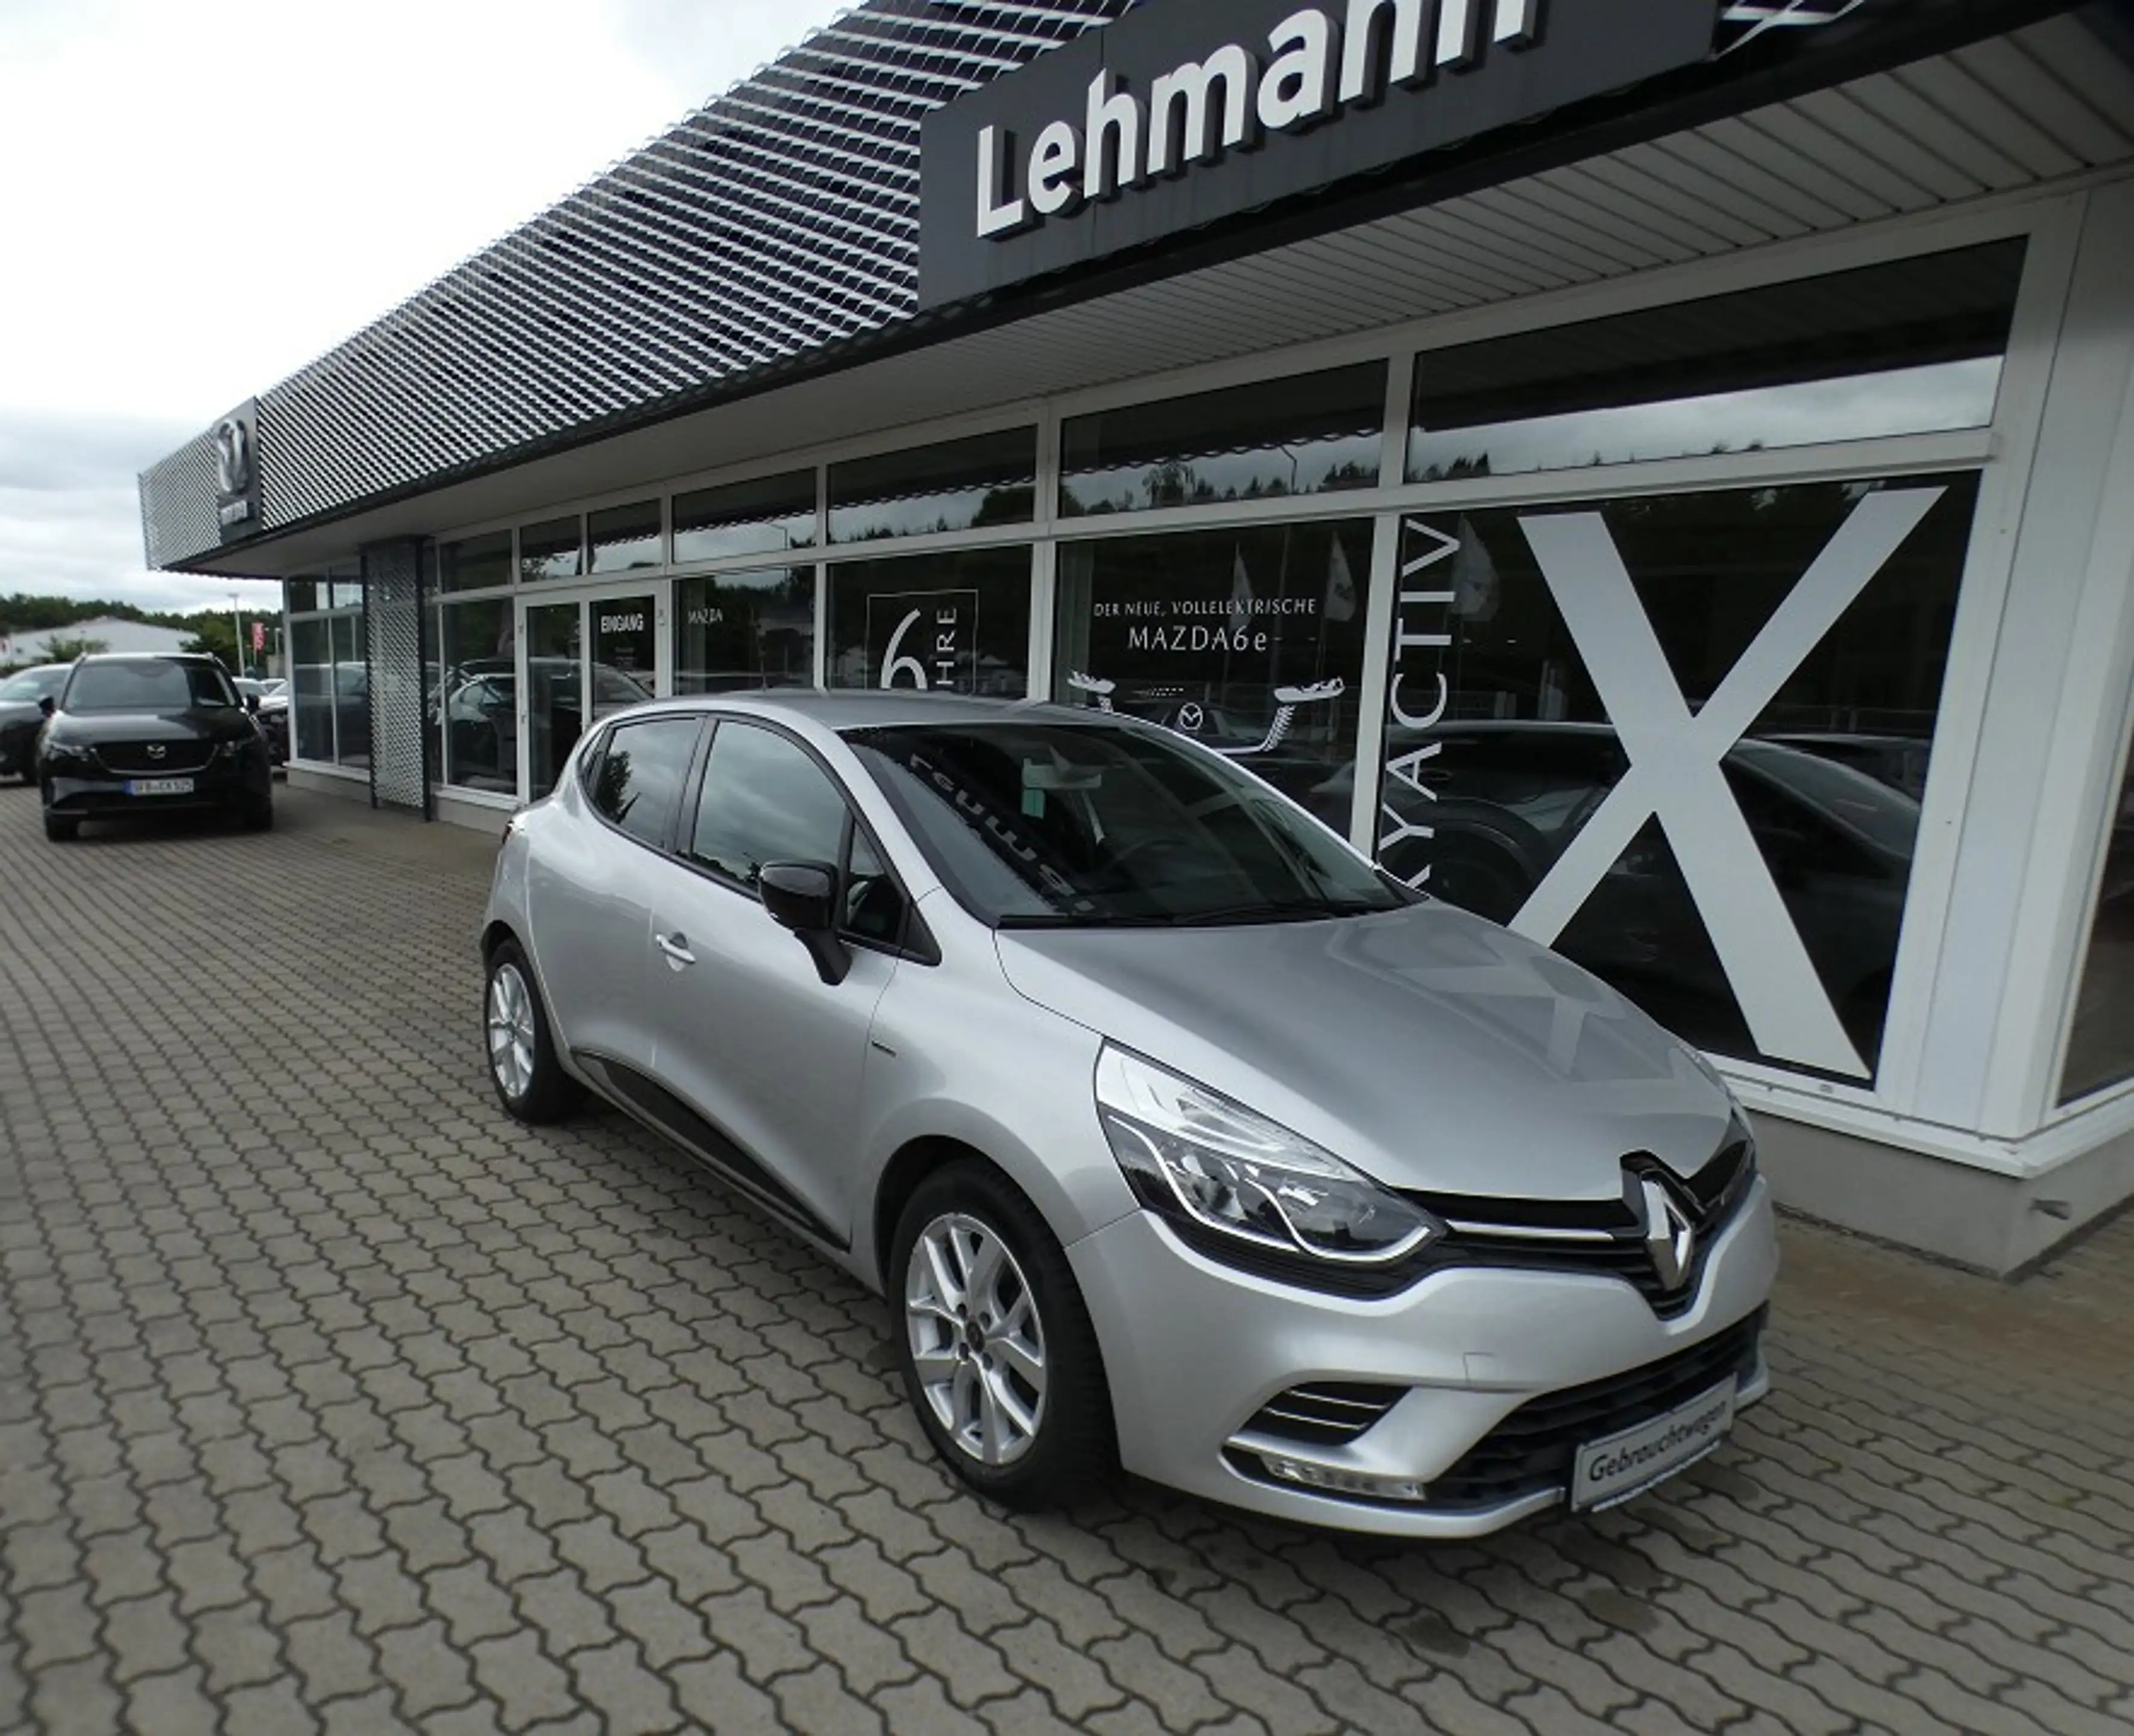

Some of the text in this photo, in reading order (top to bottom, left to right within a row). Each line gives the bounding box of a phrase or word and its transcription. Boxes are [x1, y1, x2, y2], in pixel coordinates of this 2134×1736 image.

[1094, 603, 1121, 617] DER
[1171, 599, 1317, 615] VOLLELEKTRISCHE
[1128, 625, 1268, 652] MAZDA6e
